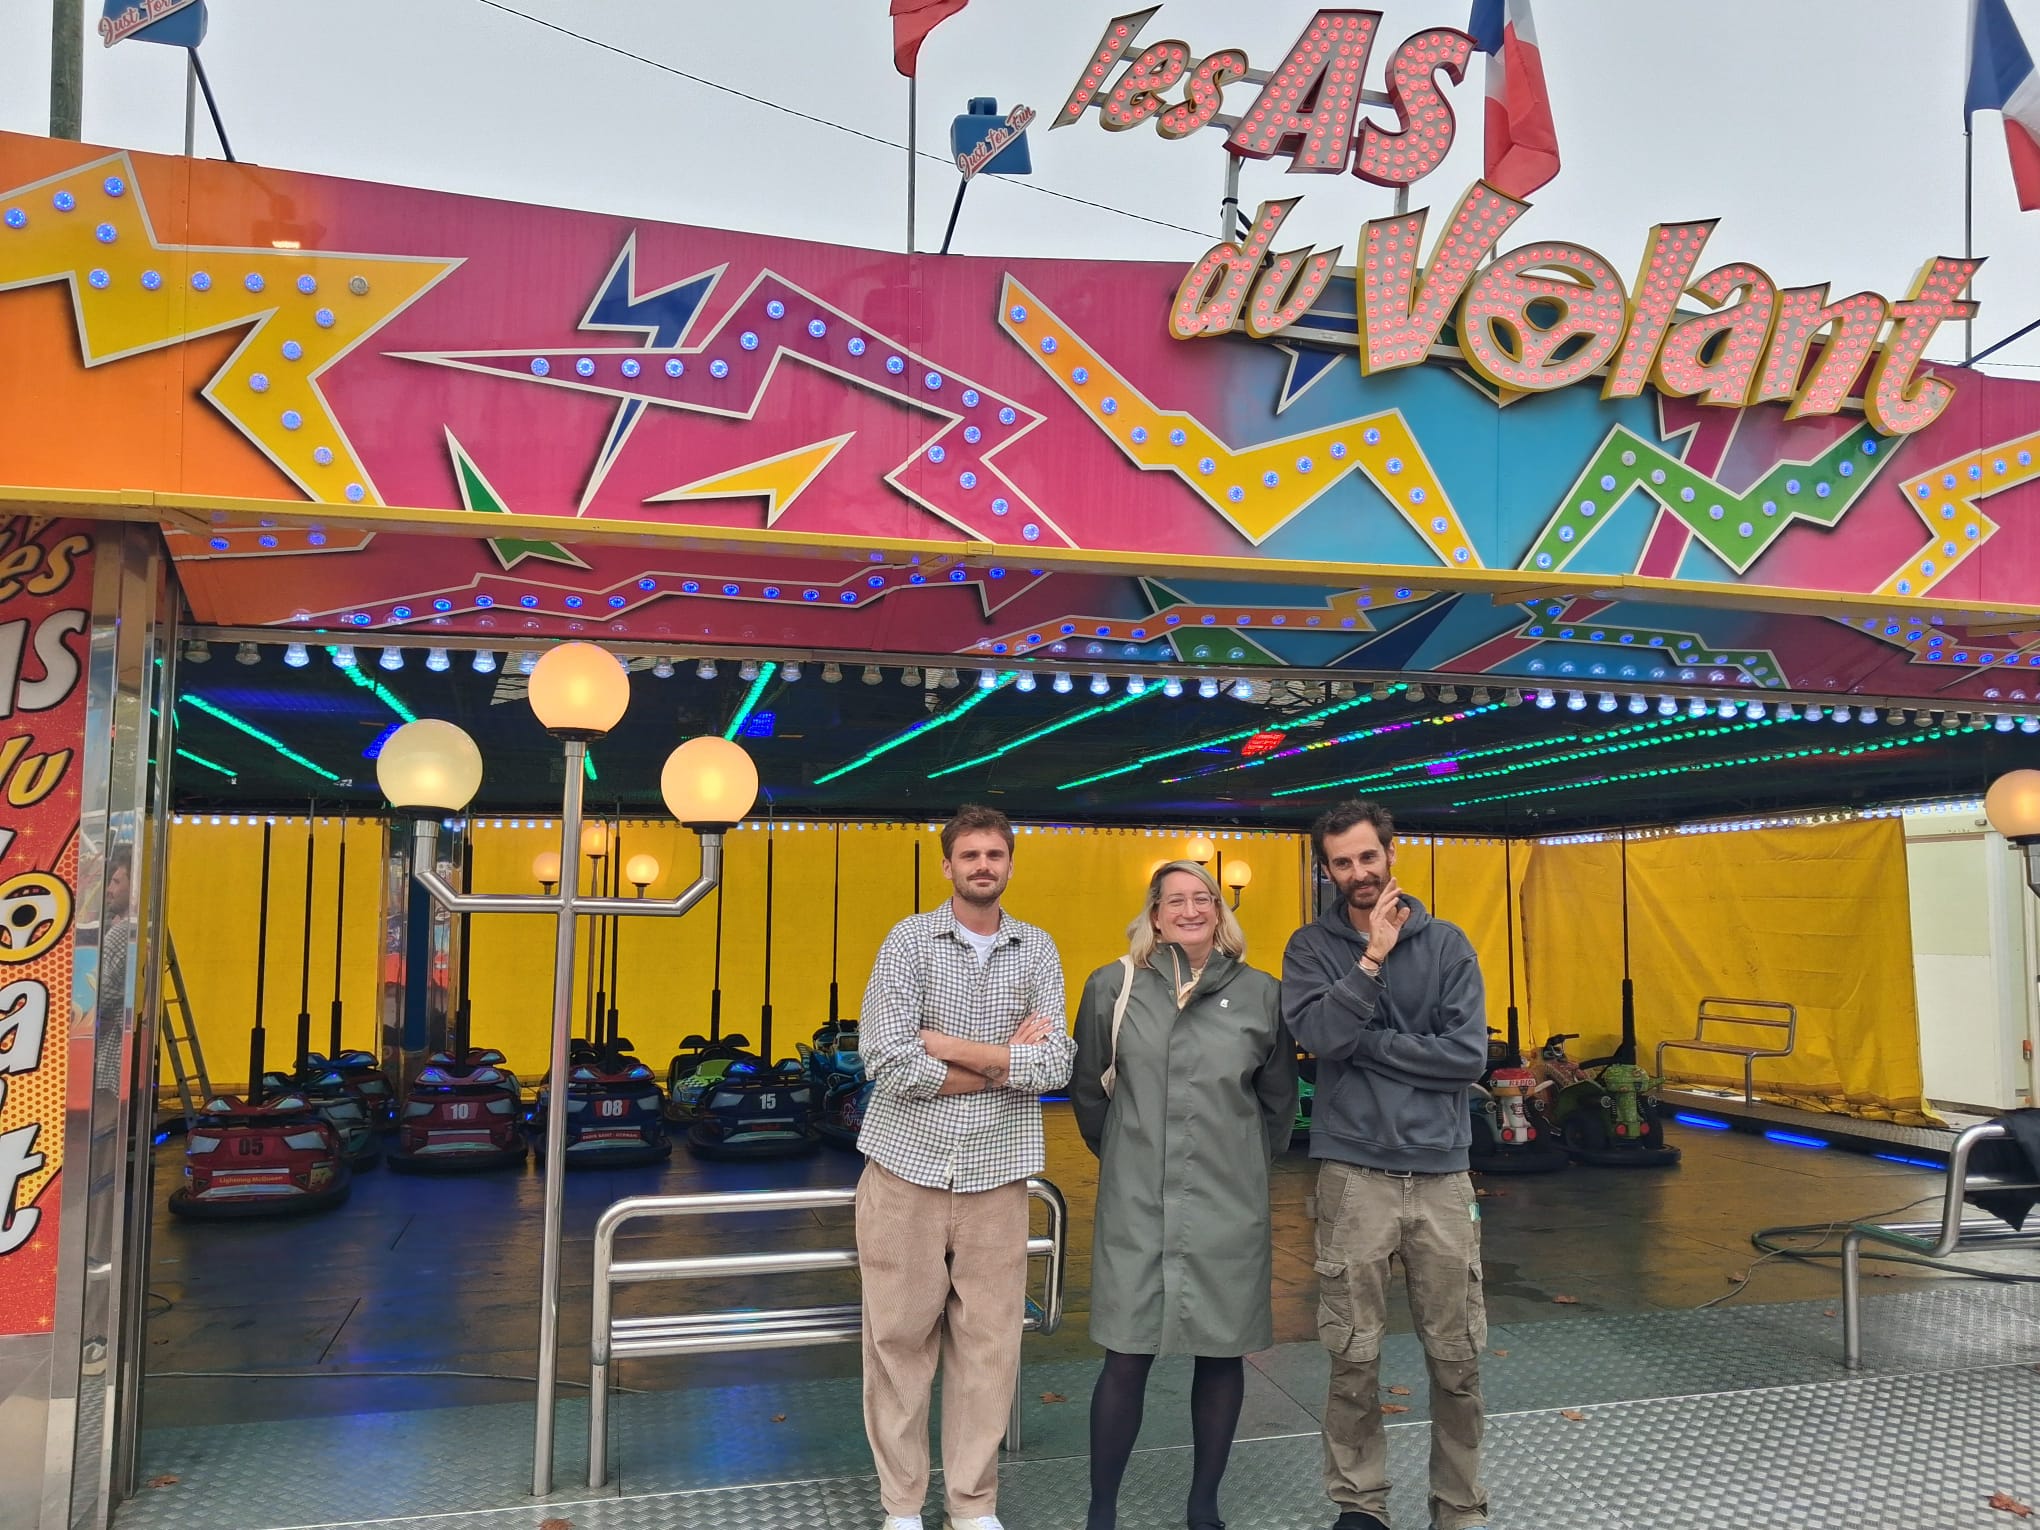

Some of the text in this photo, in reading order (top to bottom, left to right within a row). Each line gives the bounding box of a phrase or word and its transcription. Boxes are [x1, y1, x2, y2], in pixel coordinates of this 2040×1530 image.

[97, 7, 140, 45] Just
[1048, 3, 1478, 188] les AS
[958, 104, 1036, 180] Just for Fun
[1169, 178, 1990, 436] du Volant
[0, 532, 90, 602] es
[0, 736, 71, 804] u
[450, 1103, 469, 1120] 10
[602, 1099, 623, 1117] 08
[759, 1093, 777, 1110] 15
[238, 1136, 264, 1156] 05
[219, 1176, 252, 1185] Lightning
